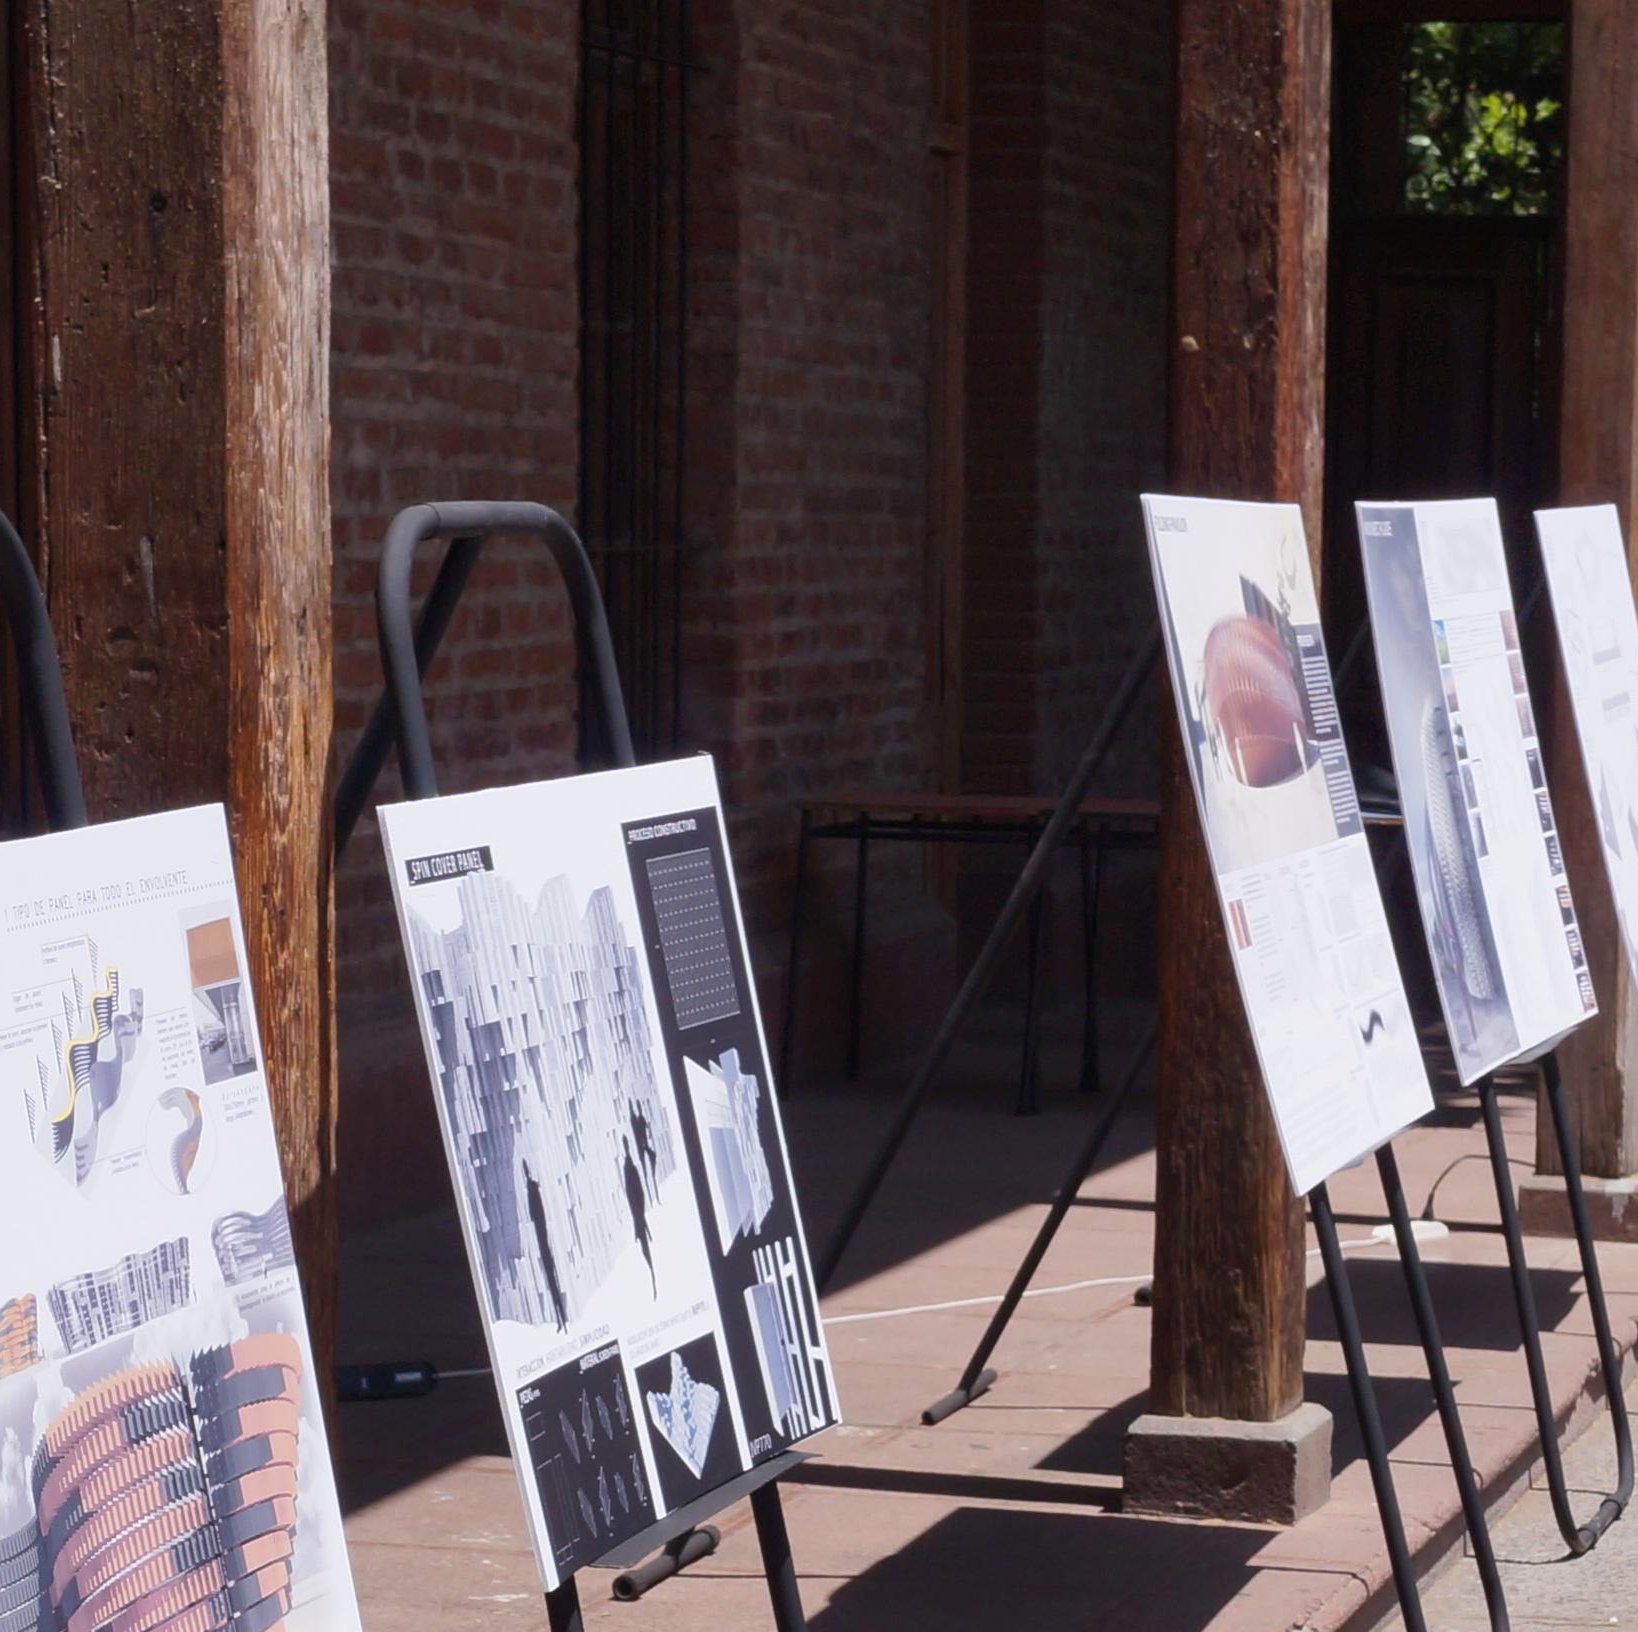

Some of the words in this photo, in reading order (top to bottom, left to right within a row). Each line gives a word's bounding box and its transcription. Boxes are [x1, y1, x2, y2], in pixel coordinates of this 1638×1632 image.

[411, 860, 431, 880] SPIN
[430, 855, 458, 876] COVER
[457, 850, 484, 871] PANEL
[49, 895, 74, 913] PANEL
[76, 890, 97, 907] PARA
[100, 884, 122, 901] TODO
[139, 870, 188, 894] ENVOLVENTE
